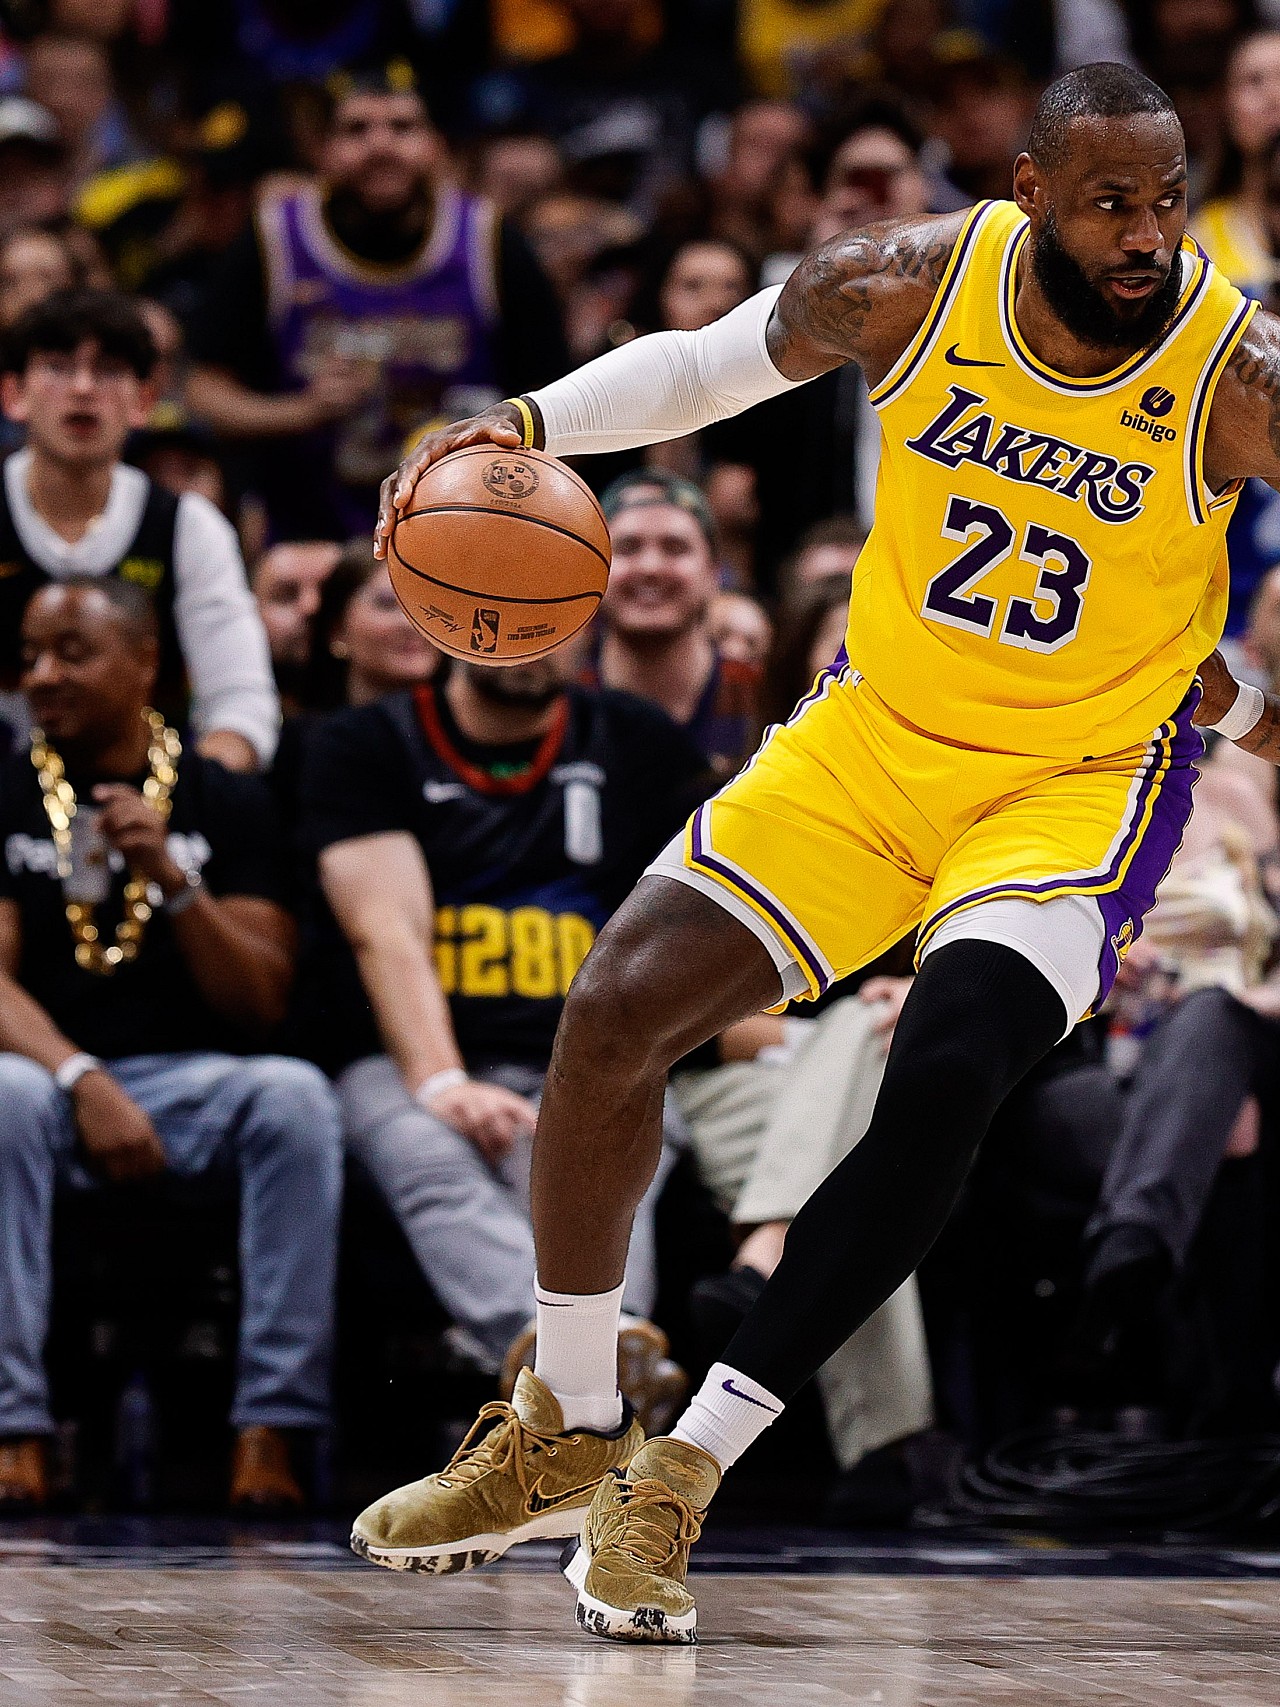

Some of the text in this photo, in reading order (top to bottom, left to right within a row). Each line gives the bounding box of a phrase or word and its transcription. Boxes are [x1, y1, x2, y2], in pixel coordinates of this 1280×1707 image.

[903, 382, 1158, 526] LAKERS
[1120, 410, 1177, 443] bibigo
[920, 493, 1093, 655] 23
